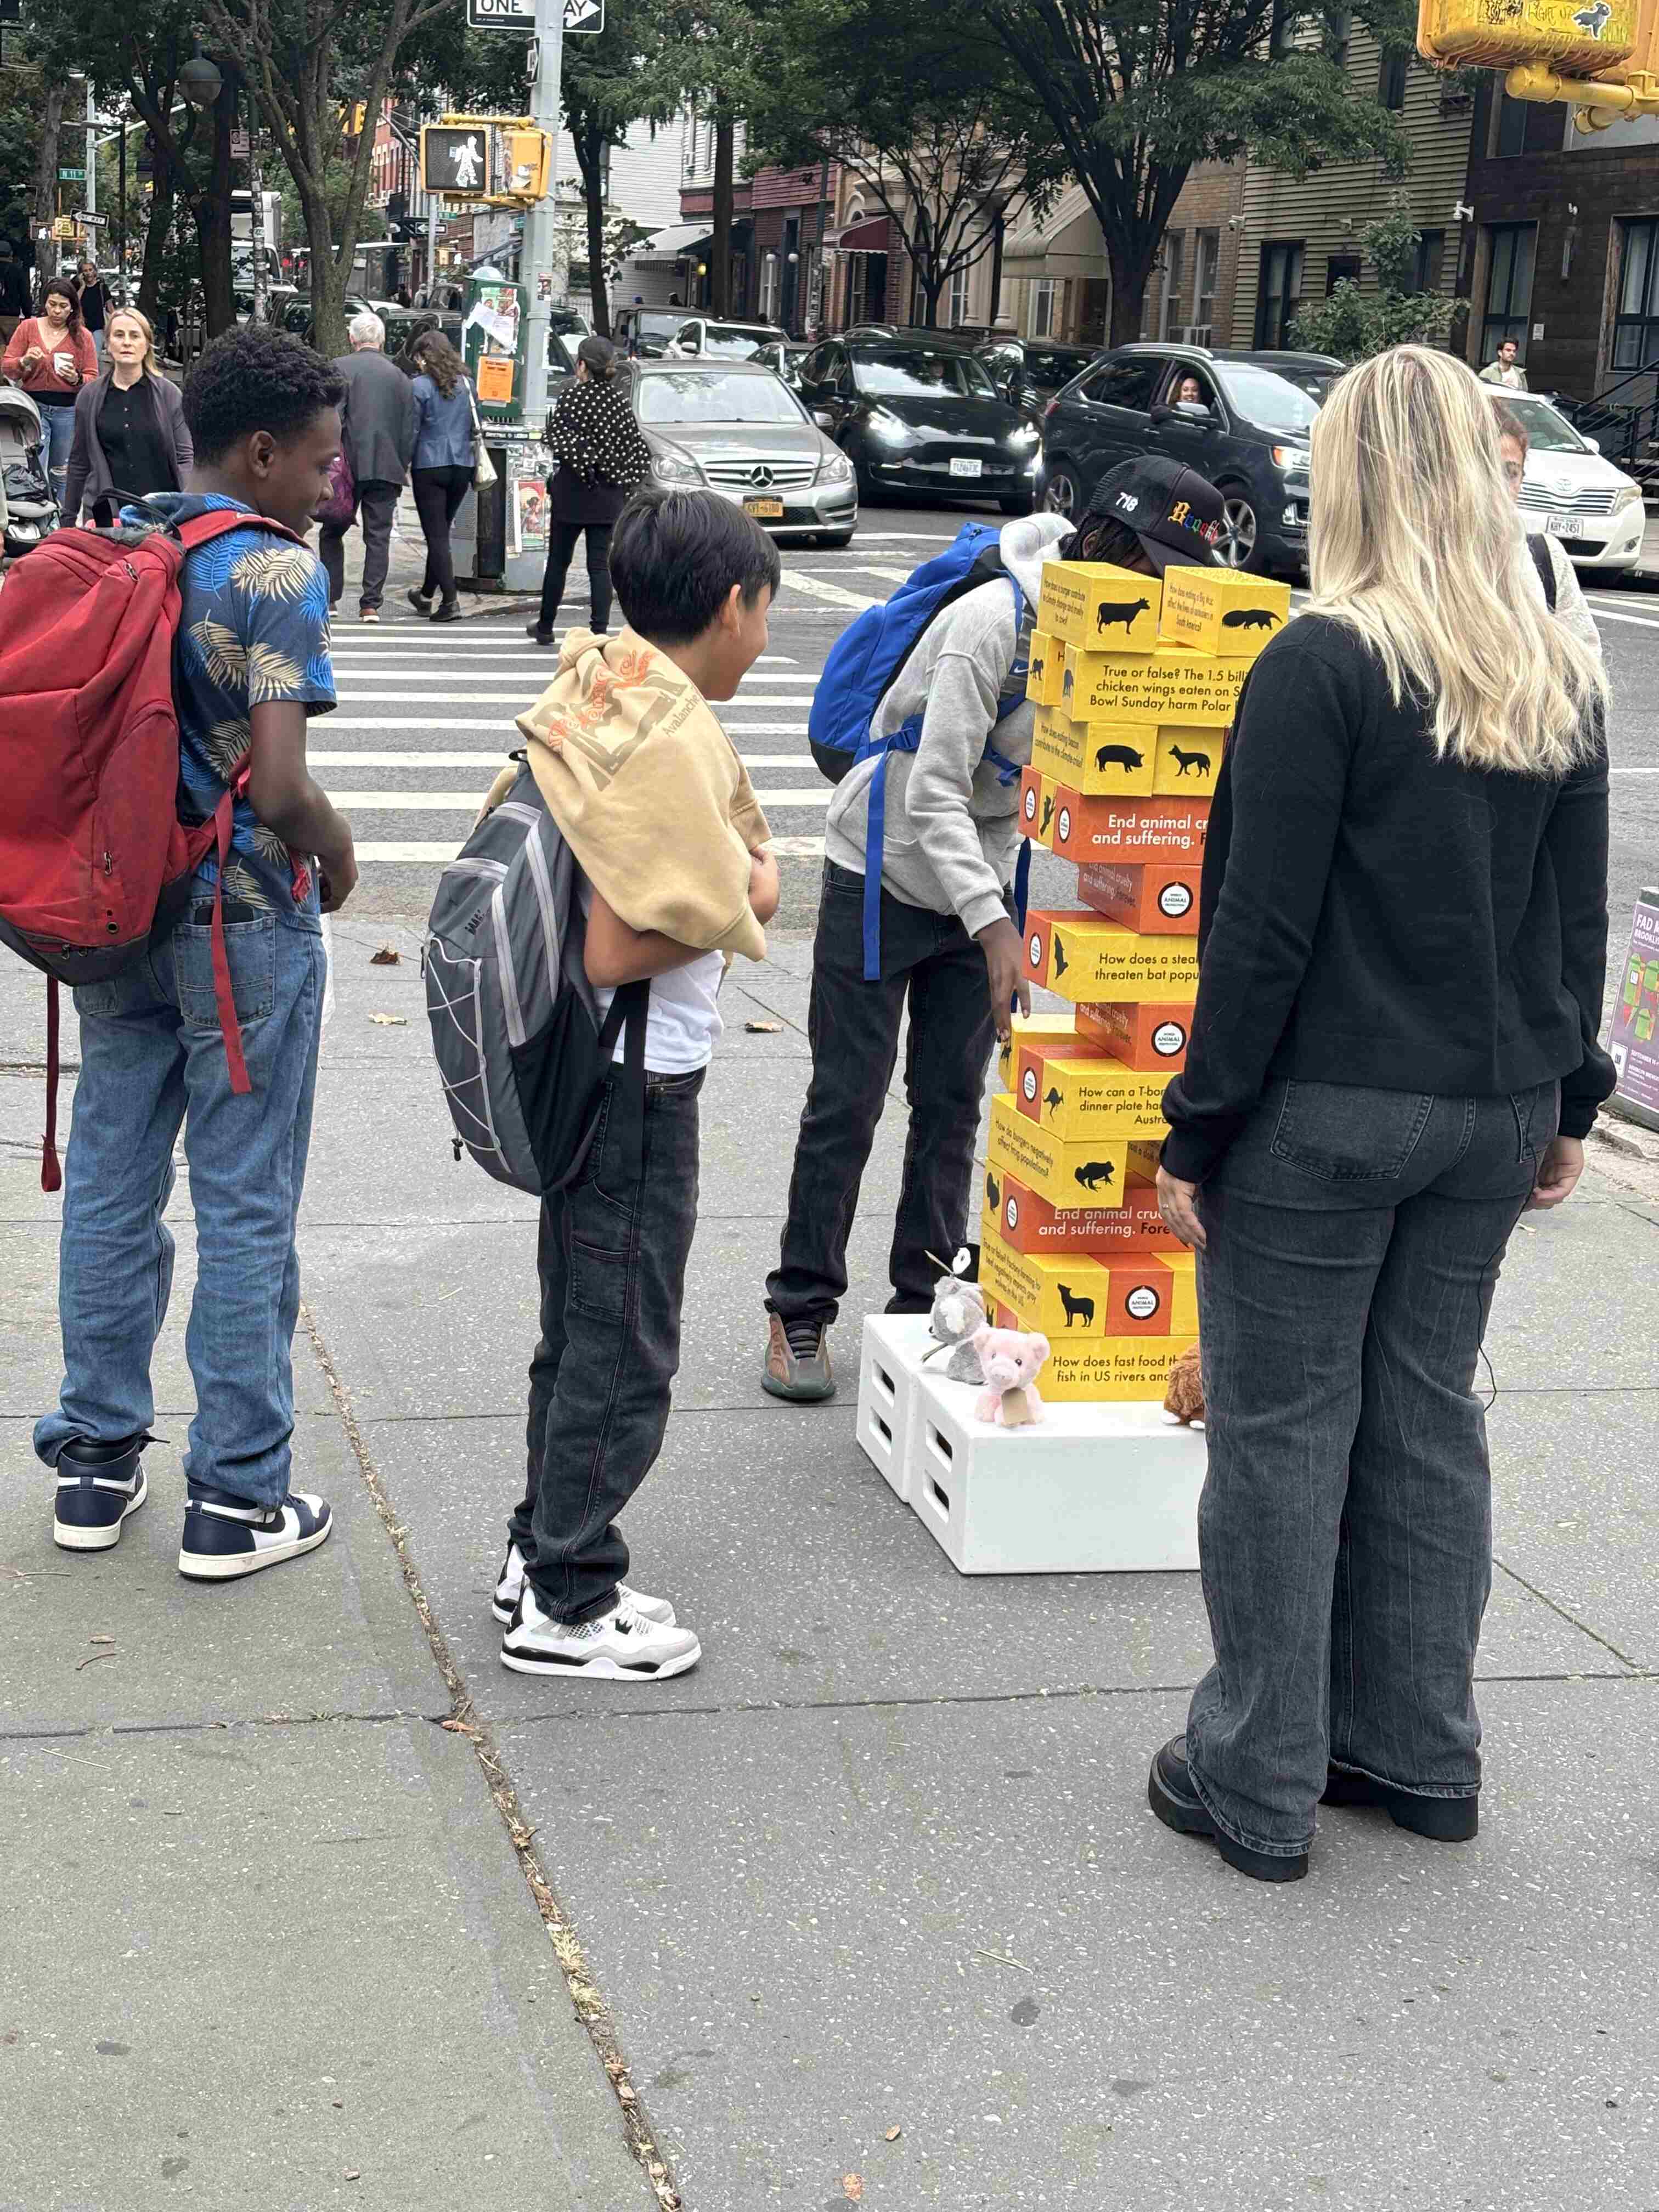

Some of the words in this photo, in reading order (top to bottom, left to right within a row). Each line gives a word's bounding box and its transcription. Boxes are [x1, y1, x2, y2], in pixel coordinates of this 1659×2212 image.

[481, 0, 522, 13] ONE
[563, 0, 588, 16] AY
[1116, 492, 1139, 511] 718
[1103, 665, 1127, 678] True
[1131, 668, 1142, 678] or
[1147, 666, 1180, 680] false?
[1184, 669, 1204, 681] The
[1208, 670, 1224, 682] 1.5
[1096, 679, 1138, 693] chicken
[1143, 682, 1175, 697] wings
[1180, 685, 1211, 696] eaten
[1216, 687, 1229, 697] on
[1090, 695, 1118, 707] Bowl
[1121, 696, 1165, 712] Sunday
[1169, 697, 1198, 710] harm
[1201, 700, 1232, 712] Polar
[1109, 814, 1136, 829] End
[1141, 814, 1191, 830] animal
[1092, 830, 1121, 844] and
[1126, 830, 1195, 850] suffering.
[1084, 872, 1092, 884] and
[1637, 913, 1653, 931] FAD
[1099, 953, 1125, 964] How
[1129, 952, 1157, 965] does
[1161, 956, 1168, 964] a
[1095, 968, 1143, 980] threaten
[1147, 968, 1166, 980] bat
[1079, 1087, 1103, 1097] How
[1106, 1089, 1125, 1097] can
[1080, 1101, 1113, 1111] dinner
[1116, 1101, 1143, 1113] plate
[1054, 1207, 1080, 1220] End
[1085, 1207, 1132, 1220] animal
[1039, 1223, 1066, 1235] and
[1070, 1222, 1136, 1238] suffering.
[1141, 1223, 1170, 1234] Fore
[1053, 1356, 1080, 1367] How
[1084, 1355, 1110, 1367] does
[1114, 1355, 1135, 1367] fast
[1138, 1355, 1165, 1367] food
[1057, 1370, 1076, 1382] fish
[1080, 1372, 1090, 1381] in
[1094, 1371, 1110, 1382] US
[1114, 1371, 1145, 1382] rivers
